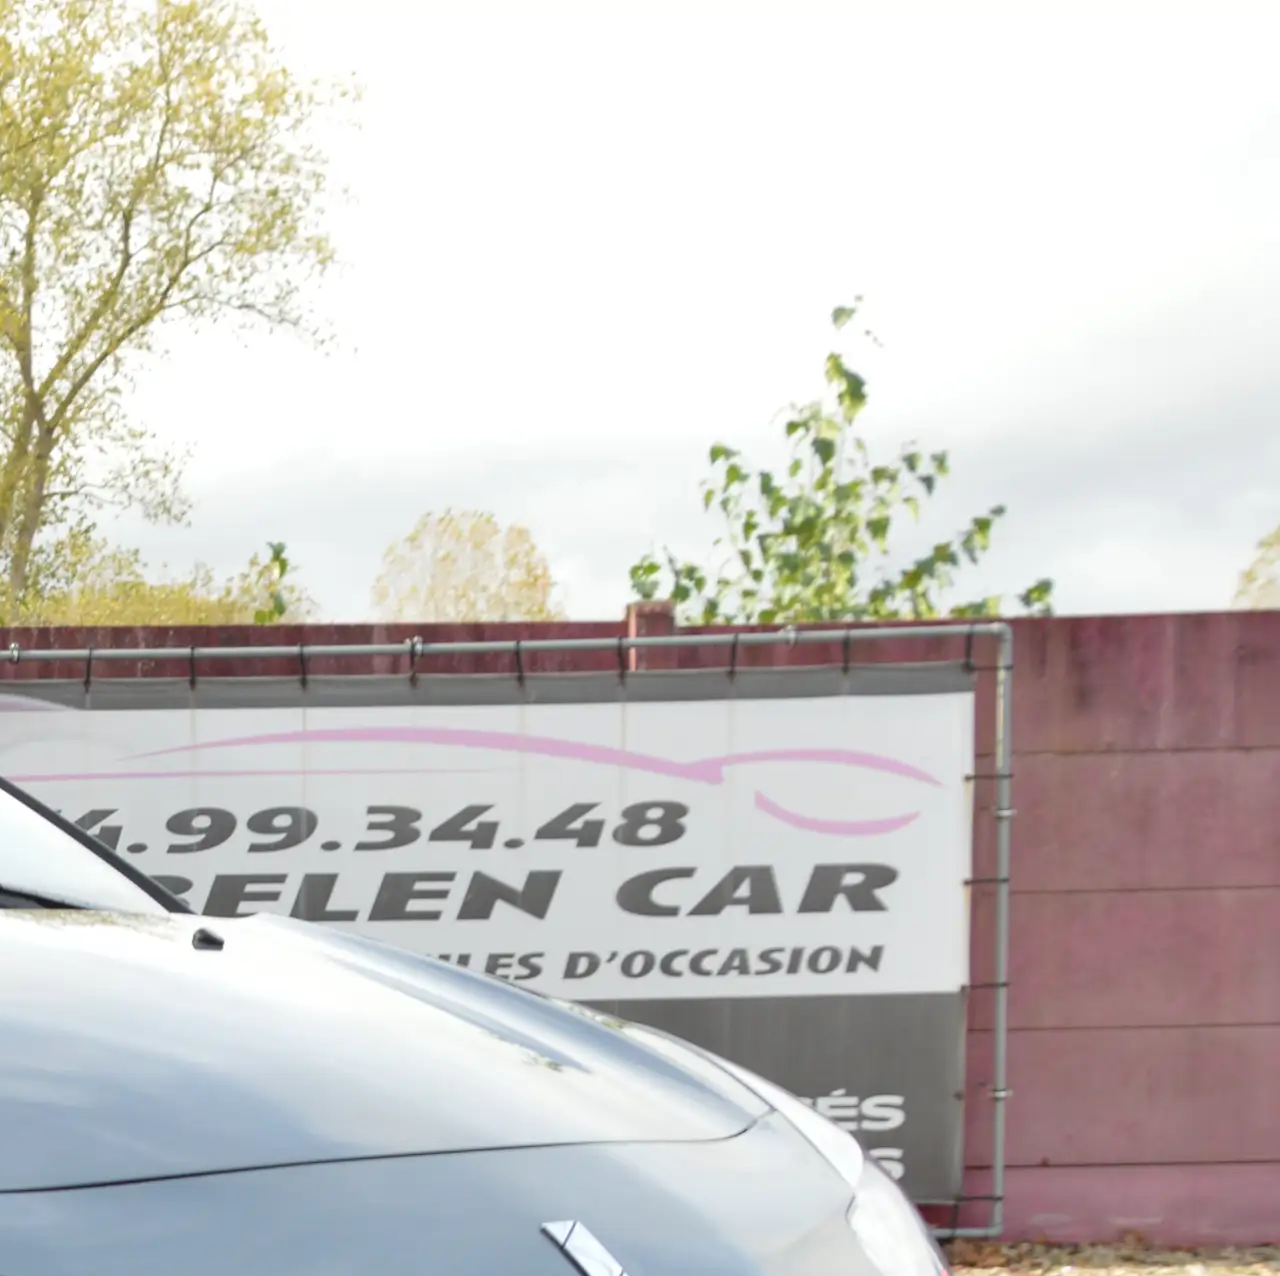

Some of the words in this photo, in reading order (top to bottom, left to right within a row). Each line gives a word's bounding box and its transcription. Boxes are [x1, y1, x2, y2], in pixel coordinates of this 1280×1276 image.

[56, 800, 690, 855] 4.99.34.48
[615, 862, 901, 918] CAR
[562, 944, 885, 982] D'OCCASION
